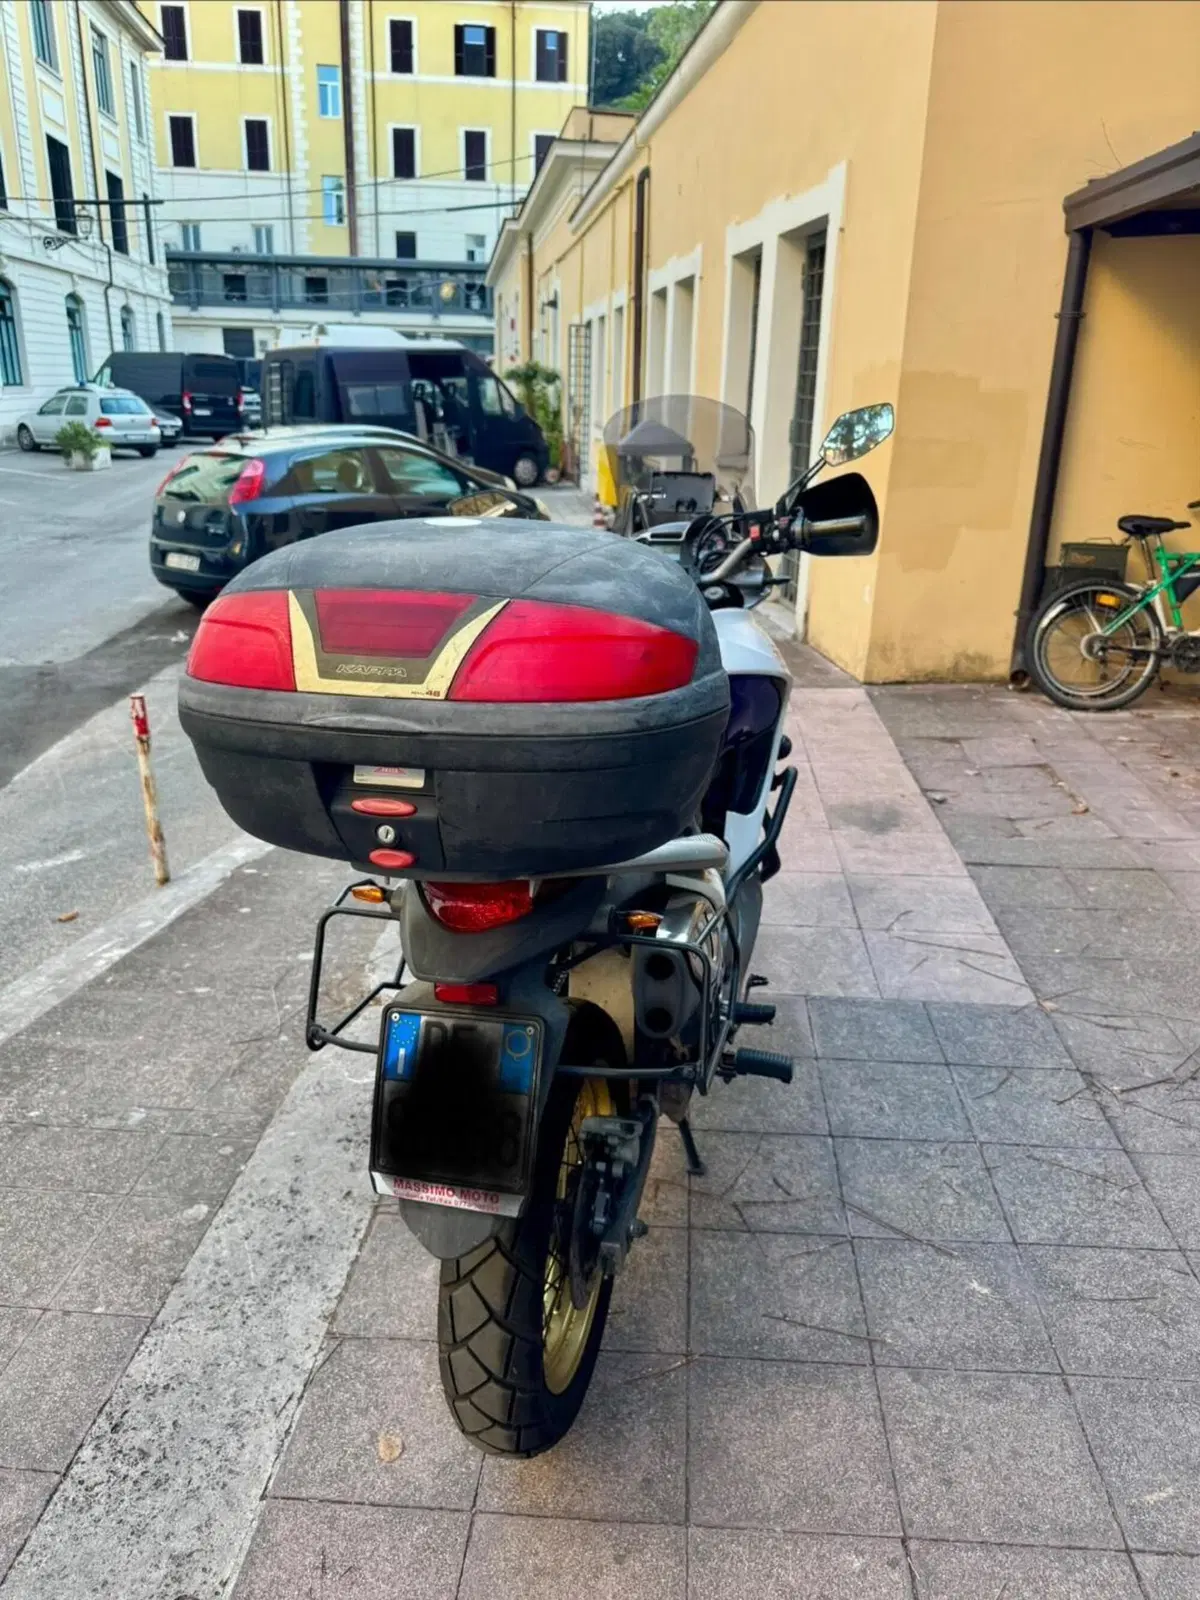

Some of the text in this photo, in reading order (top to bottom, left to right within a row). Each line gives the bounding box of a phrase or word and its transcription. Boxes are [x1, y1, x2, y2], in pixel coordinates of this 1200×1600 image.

[335, 663, 408, 678] KAPPA
[392, 1176, 456, 1198] MASSIMO
[459, 1188, 500, 1204] MOTO
